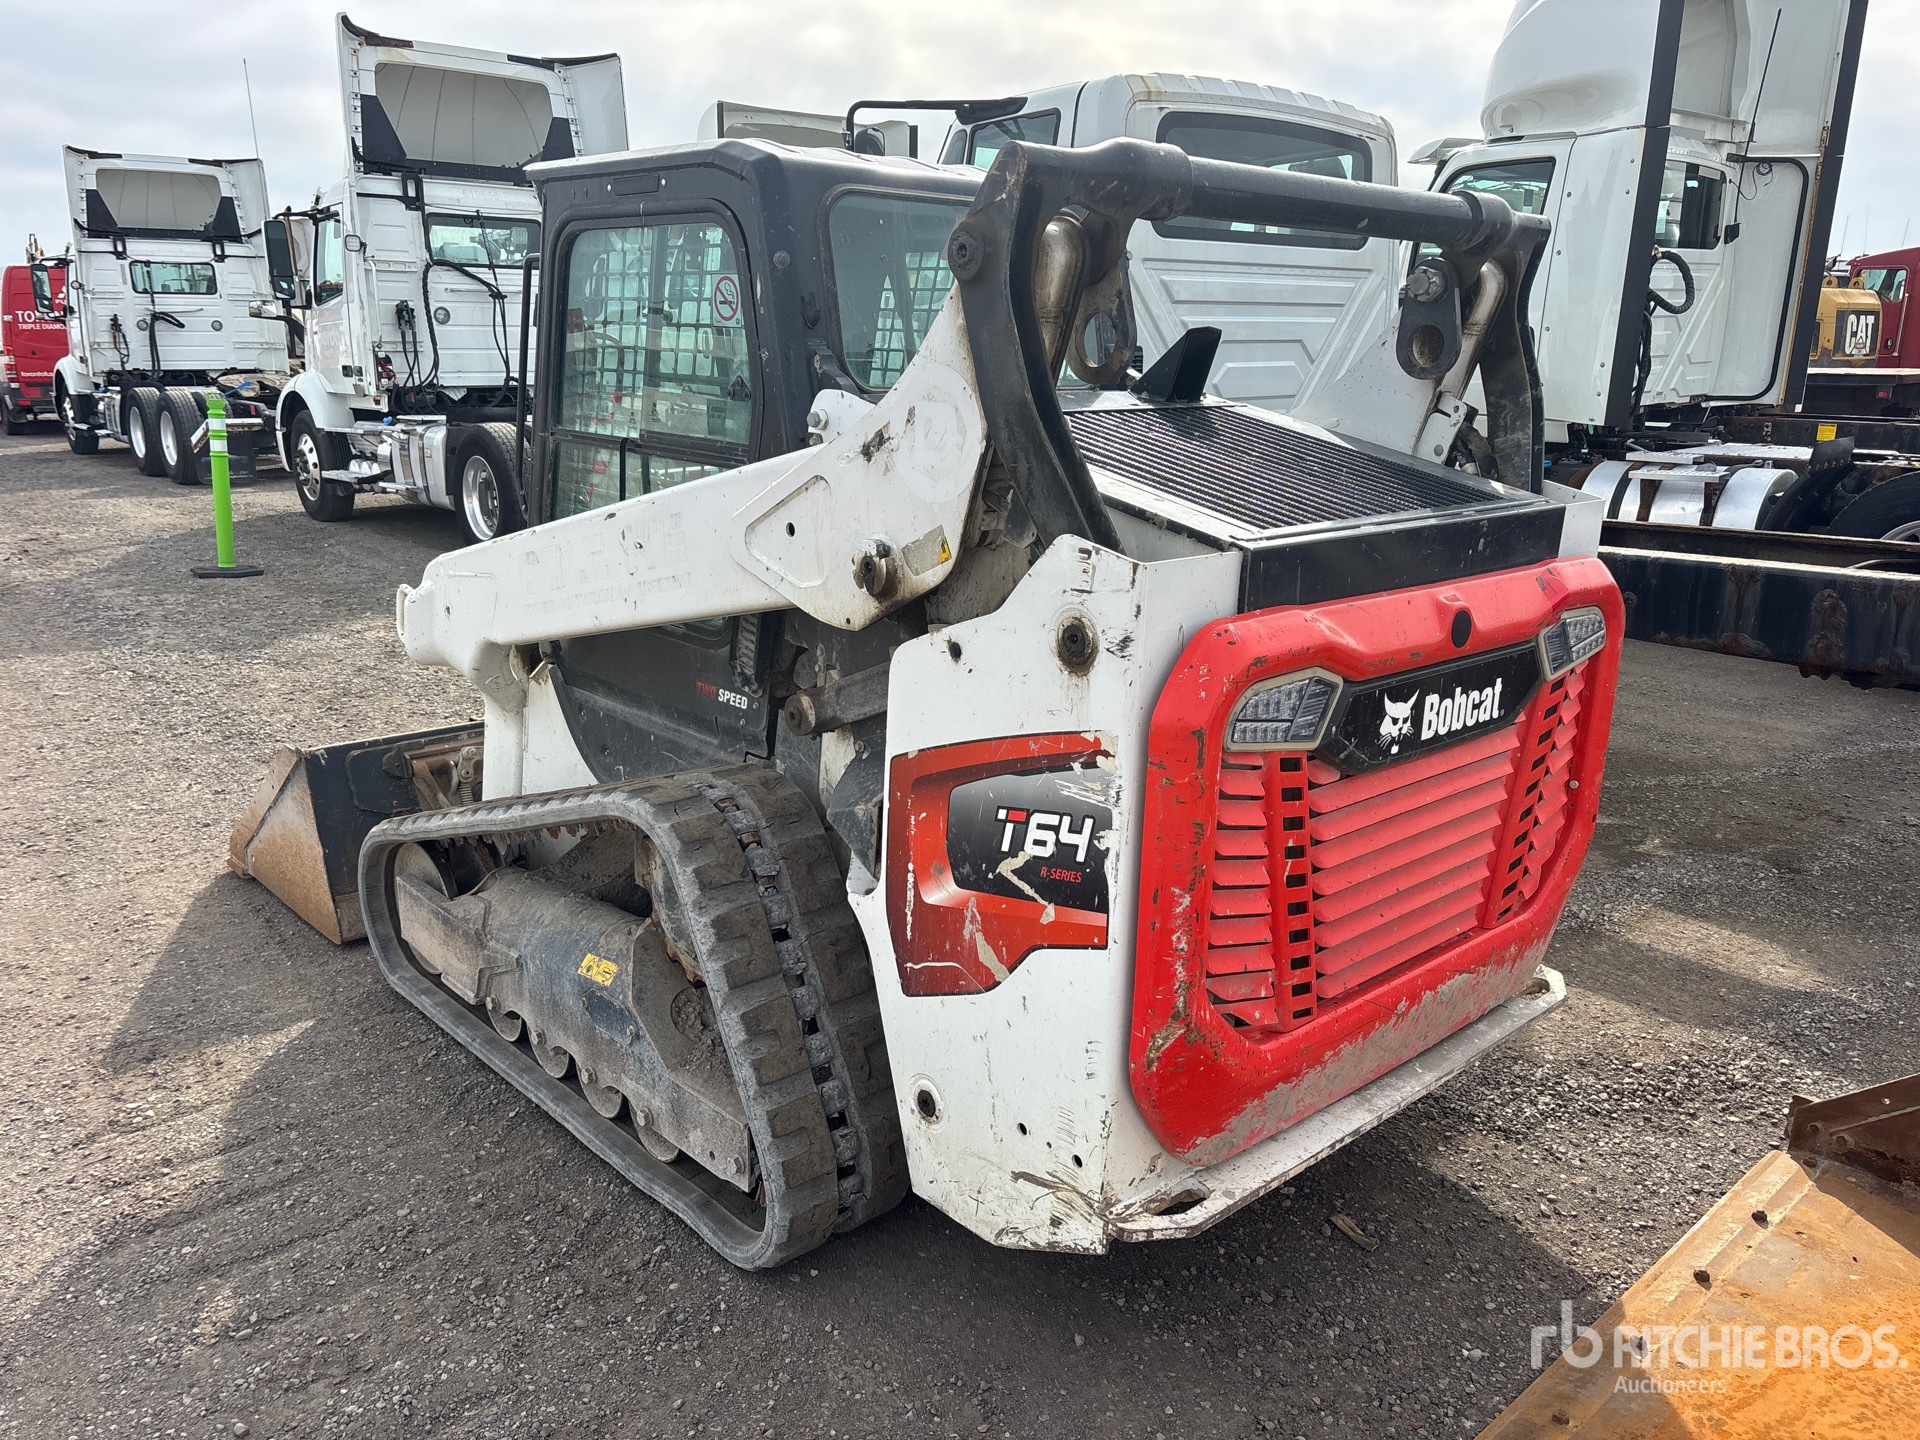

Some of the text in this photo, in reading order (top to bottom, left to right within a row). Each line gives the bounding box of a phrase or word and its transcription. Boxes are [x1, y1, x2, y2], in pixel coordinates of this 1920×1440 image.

[1845, 314, 1875, 354] CAT
[697, 681, 748, 710] TWO SPEED
[1420, 677, 1503, 741] Bobcat
[997, 808, 1094, 863] T64
[1040, 866, 1083, 883] R-SERIES
